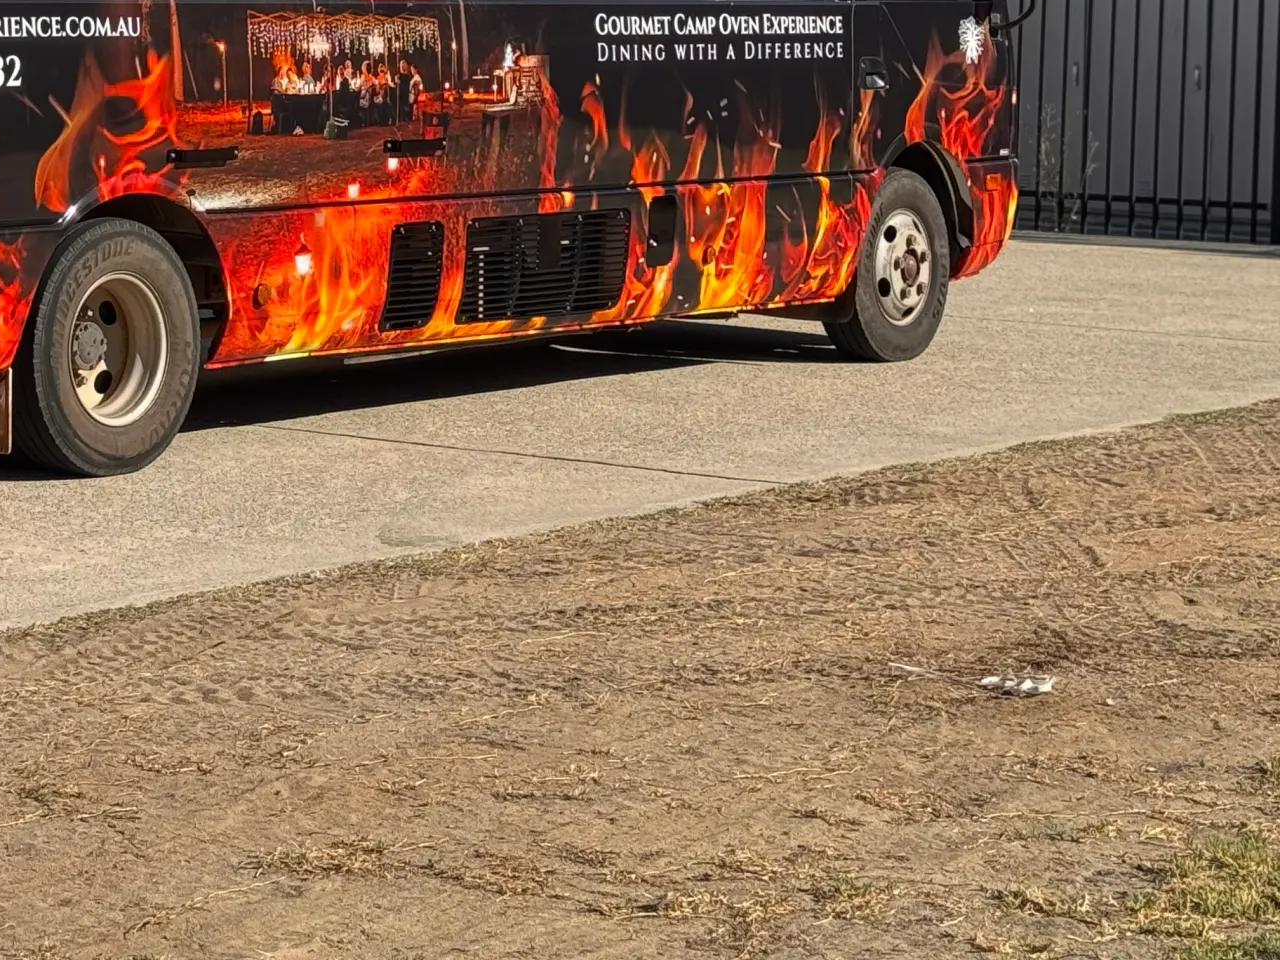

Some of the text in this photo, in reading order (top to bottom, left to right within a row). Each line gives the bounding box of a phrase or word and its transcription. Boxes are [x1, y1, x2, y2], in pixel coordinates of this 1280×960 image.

[595, 13, 844, 35] GOURMET CAMP OVEN EXPERIENCE
[597, 41, 844, 61] DINING WITH A DIFFERENCE
